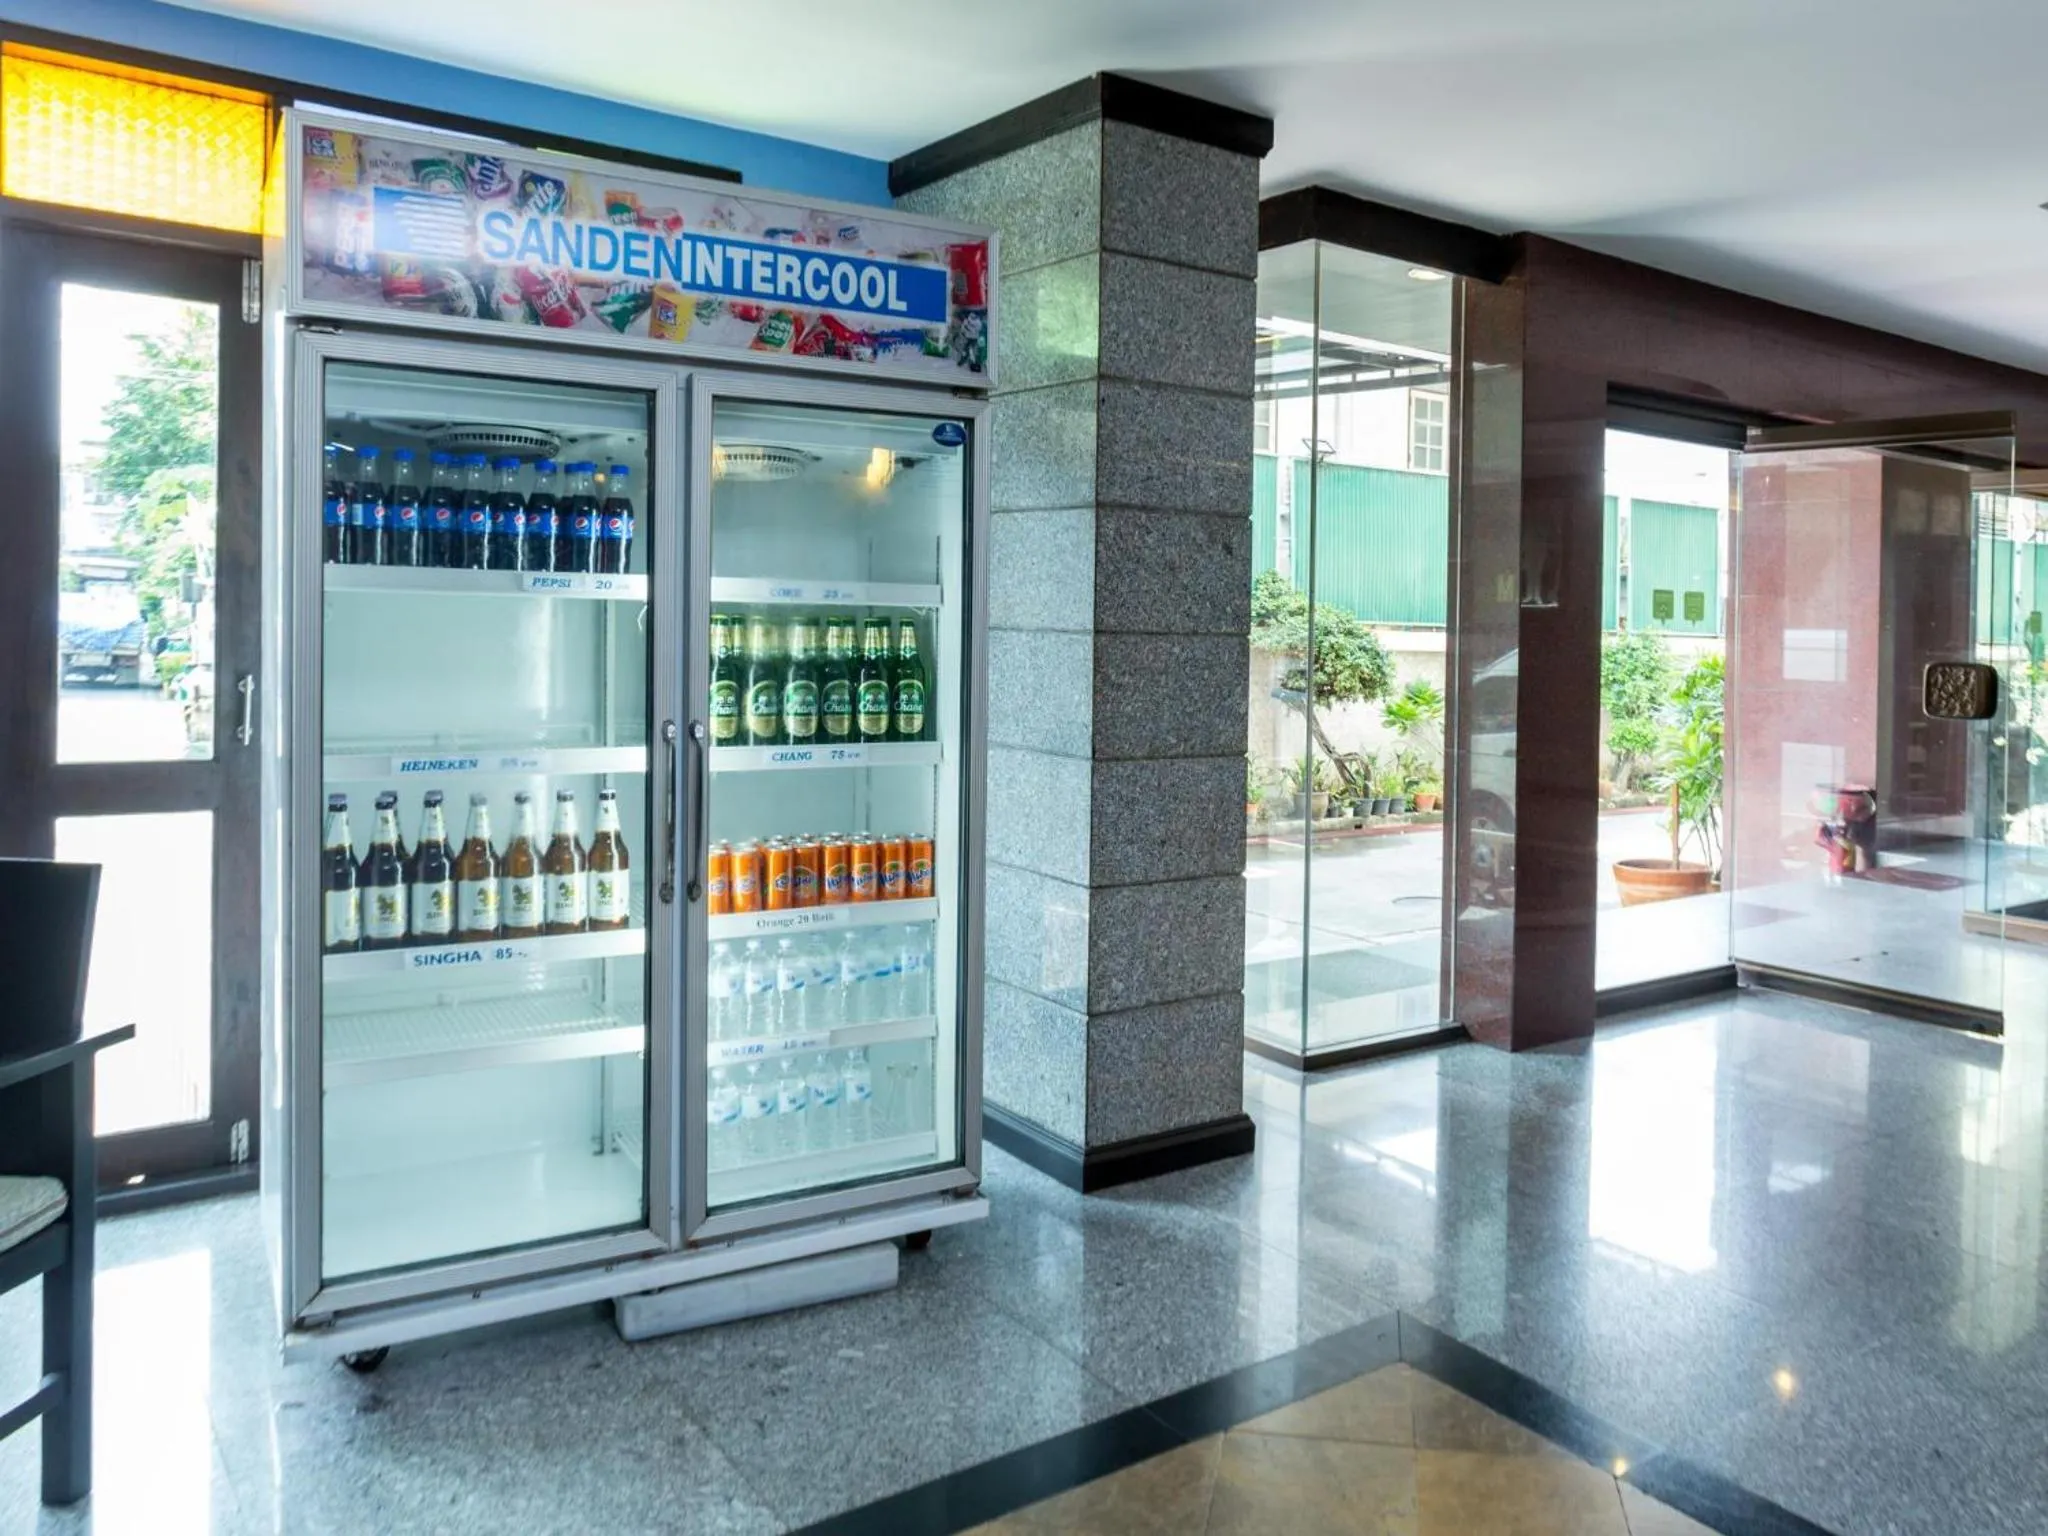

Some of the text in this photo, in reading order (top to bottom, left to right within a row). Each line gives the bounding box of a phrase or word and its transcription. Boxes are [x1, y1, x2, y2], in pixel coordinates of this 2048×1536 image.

[531, 575, 573, 589] PEPSI
[595, 579, 613, 590] 20
[771, 751, 813, 762] CHANG
[831, 750, 845, 761] 75
[400, 757, 479, 772] HEINEKEN
[757, 917, 795, 930] Orange
[797, 914, 809, 924] 20
[413, 950, 482, 968] SINGHA
